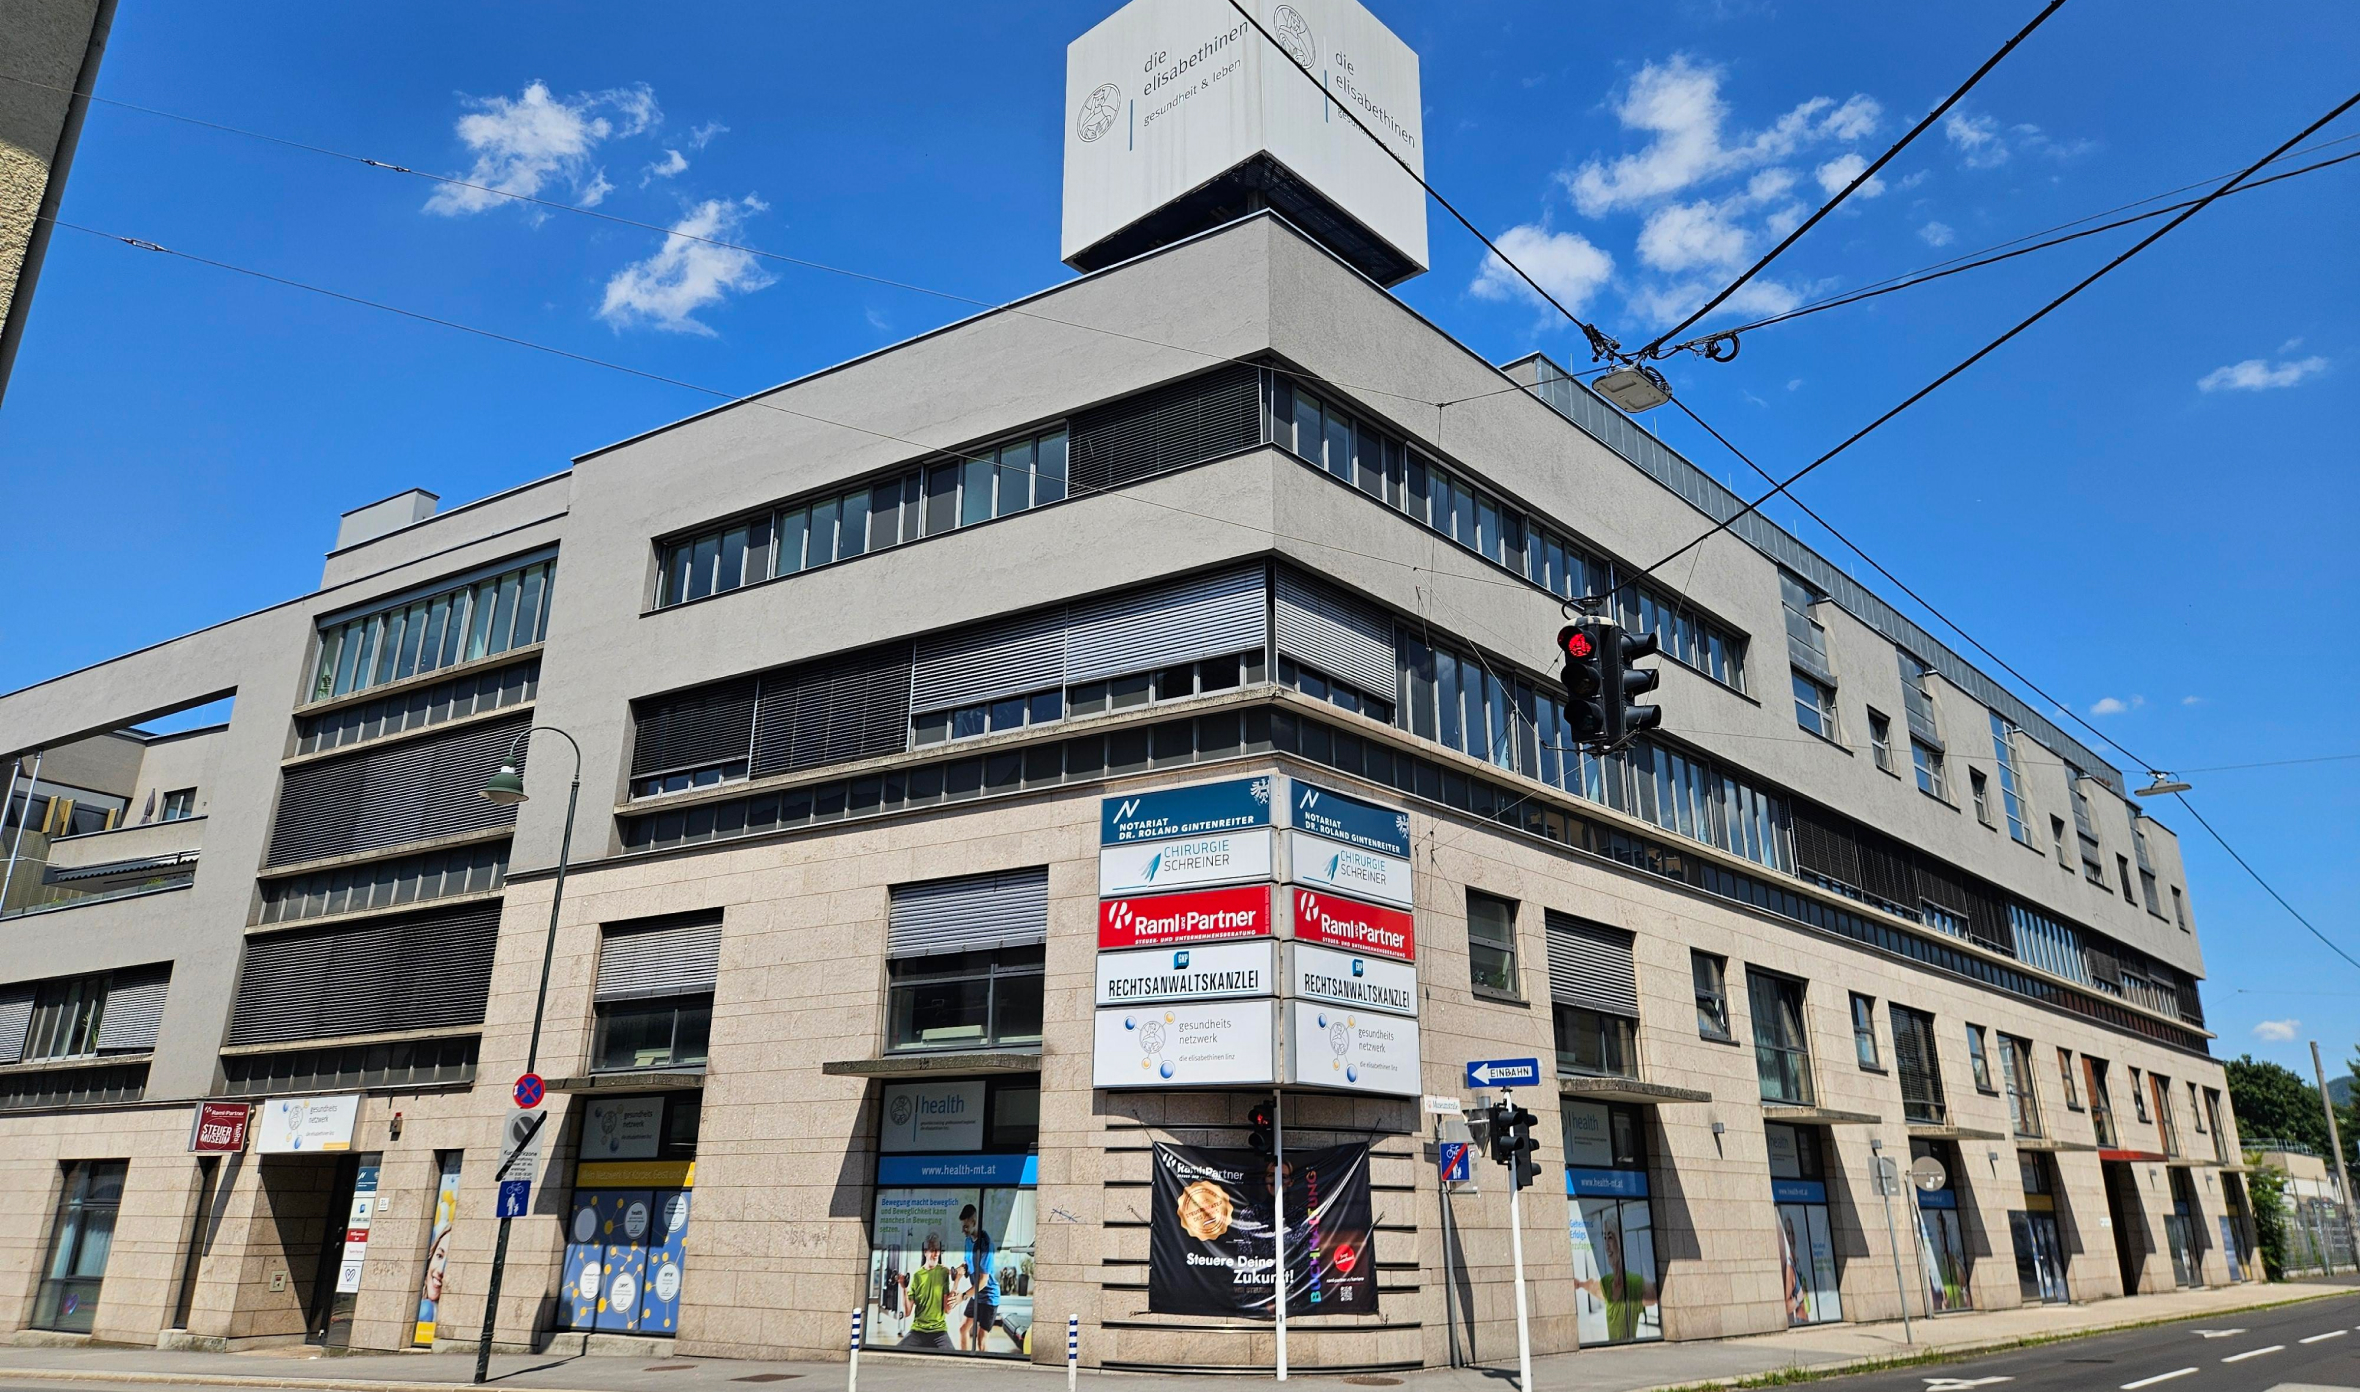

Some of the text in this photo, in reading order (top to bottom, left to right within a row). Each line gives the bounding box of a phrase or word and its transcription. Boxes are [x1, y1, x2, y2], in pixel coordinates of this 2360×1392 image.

[1144, 21, 1248, 96] elisabethinen
[1144, 50, 1167, 73] die
[1335, 50, 1354, 76] die
[1143, 59, 1241, 127] gesundheit & leben
[1336, 75, 1415, 148] elisabethinen
[1119, 817, 1169, 832] NOTARIAT
[1304, 811, 1342, 829] NOTARIAT
[1118, 815, 1254, 841] DR. ROLAND GINTENREITER
[1305, 820, 1401, 854] DR. ROLAND GINTENREITER
[1164, 839, 1230, 859] CHIRURGIE
[1164, 854, 1230, 872] SCHREINER
[1340, 850, 1386, 872] CHIRURGIE
[1341, 863, 1387, 885] SCHREINER
[1175, 929, 1256, 942] UNTERNEHMENSBERATUNG
[1109, 969, 1259, 997] RECHTSANWALTSKANZLEI
[1304, 973, 1410, 1009] RECHTSANWALTSKANZLEI
[1178, 1018, 1232, 1033] gesundheits
[1179, 1033, 1218, 1045] netzwerk
[1358, 1028, 1395, 1041] gesundheits
[1358, 1041, 1386, 1054] netzwerk
[1188, 1053, 1224, 1062] elisabethinen
[1225, 1053, 1236, 1061] linz
[1490, 1066, 1529, 1078] EINBAHN
[310, 1104, 338, 1115] gesundheits
[920, 1094, 964, 1114] health
[1572, 1111, 1599, 1131] health
[202, 1123, 233, 1137] STEUER
[200, 1132, 231, 1145] MUSEUM
[921, 1164, 996, 1176] www.health-mt.at
[881, 1198, 959, 1207] Bewegung macht beweglich
[881, 1207, 892, 1215] und
[892, 1207, 932, 1216] Beweglichkeit
[880, 1216, 942, 1226] manches in Bewegung
[1569, 1229, 1587, 1243] Erfolgs
[1186, 1252, 1234, 1267] Steuere
[1237, 1255, 1275, 1268] Deine
